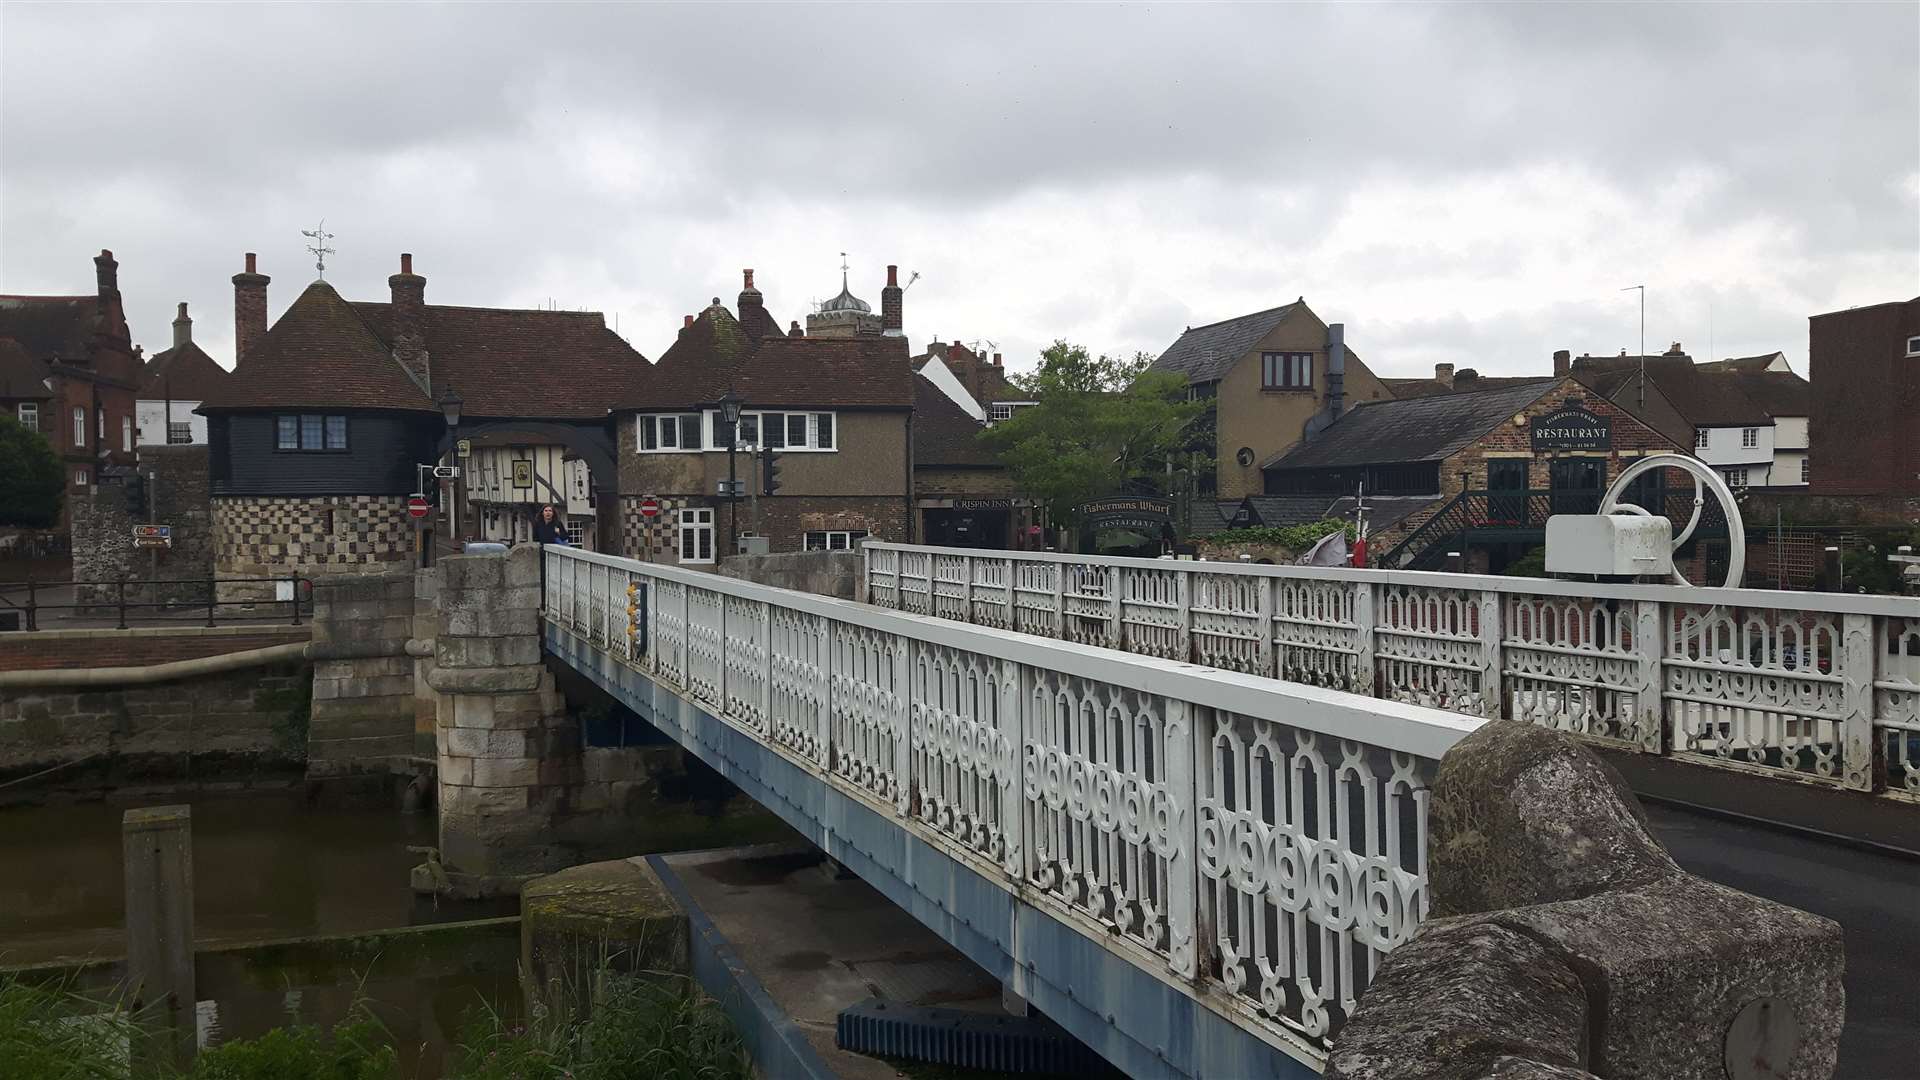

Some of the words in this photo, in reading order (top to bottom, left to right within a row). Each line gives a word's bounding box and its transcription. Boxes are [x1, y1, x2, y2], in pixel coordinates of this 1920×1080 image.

[1536, 428, 1607, 439] RESTAURANT
[992, 499, 1009, 508] INN
[1083, 502, 1137, 513] Fishermans
[1139, 501, 1170, 515] Wharf
[1099, 519, 1155, 528] RESTAURANT
